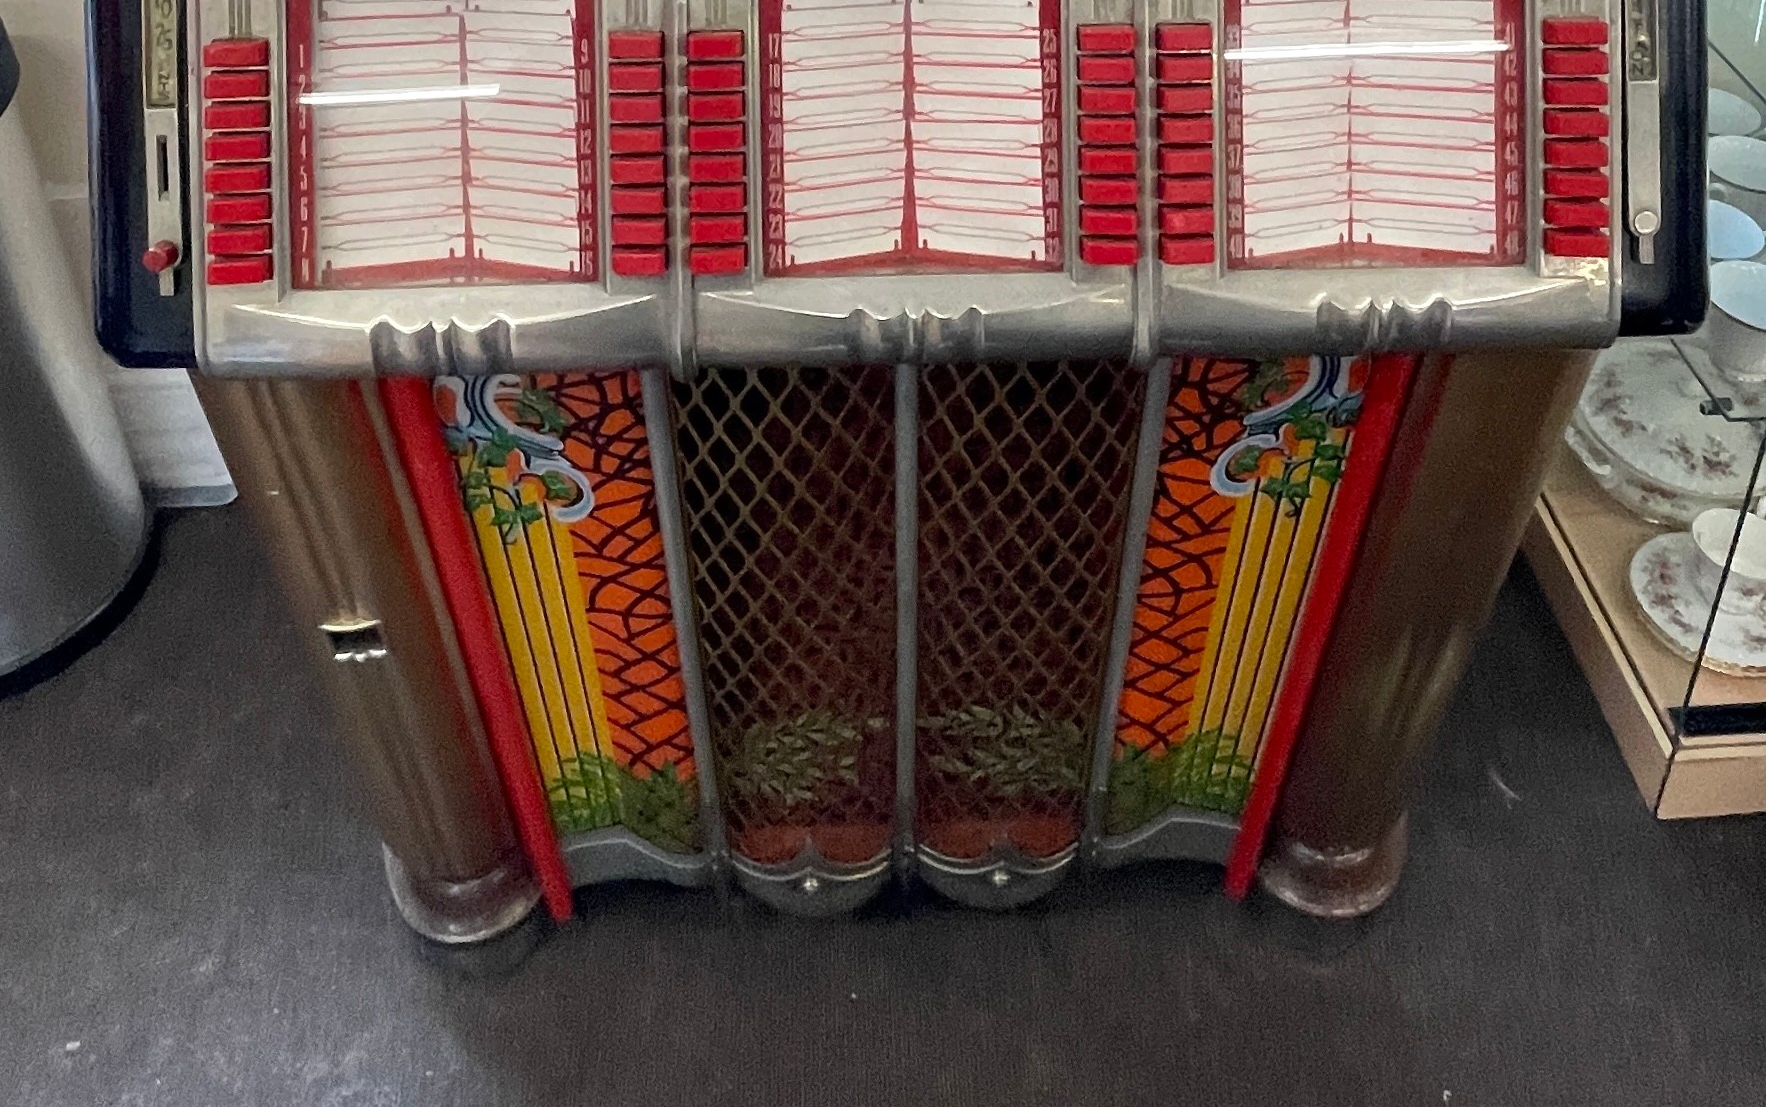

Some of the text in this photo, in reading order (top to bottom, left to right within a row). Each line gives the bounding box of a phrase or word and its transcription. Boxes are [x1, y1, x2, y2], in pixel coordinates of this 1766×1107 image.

[768, 33, 780, 59] 17
[1043, 28, 1057, 53] 25
[1504, 21, 1515, 50] 41
[581, 38, 589, 63] 9
[1043, 58, 1057, 83] 26
[1503, 52, 1517, 77] 42
[579, 68, 591, 93] 10
[1043, 88, 1057, 113] 27
[1504, 81, 1518, 108] 43
[580, 99, 590, 123] 11
[580, 128, 592, 153] 12
[1227, 144, 1240, 169] 37
[1504, 141, 1518, 166] 45
[300, 165, 308, 191] 5
[1505, 171, 1519, 196] 46
[768, 183, 783, 208] 22
[300, 196, 308, 221] 6
[1046, 207, 1058, 232] 31
[1504, 200, 1519, 225] 47
[301, 226, 308, 252] 7
[581, 220, 592, 245] 15
[769, 243, 783, 269] 24
